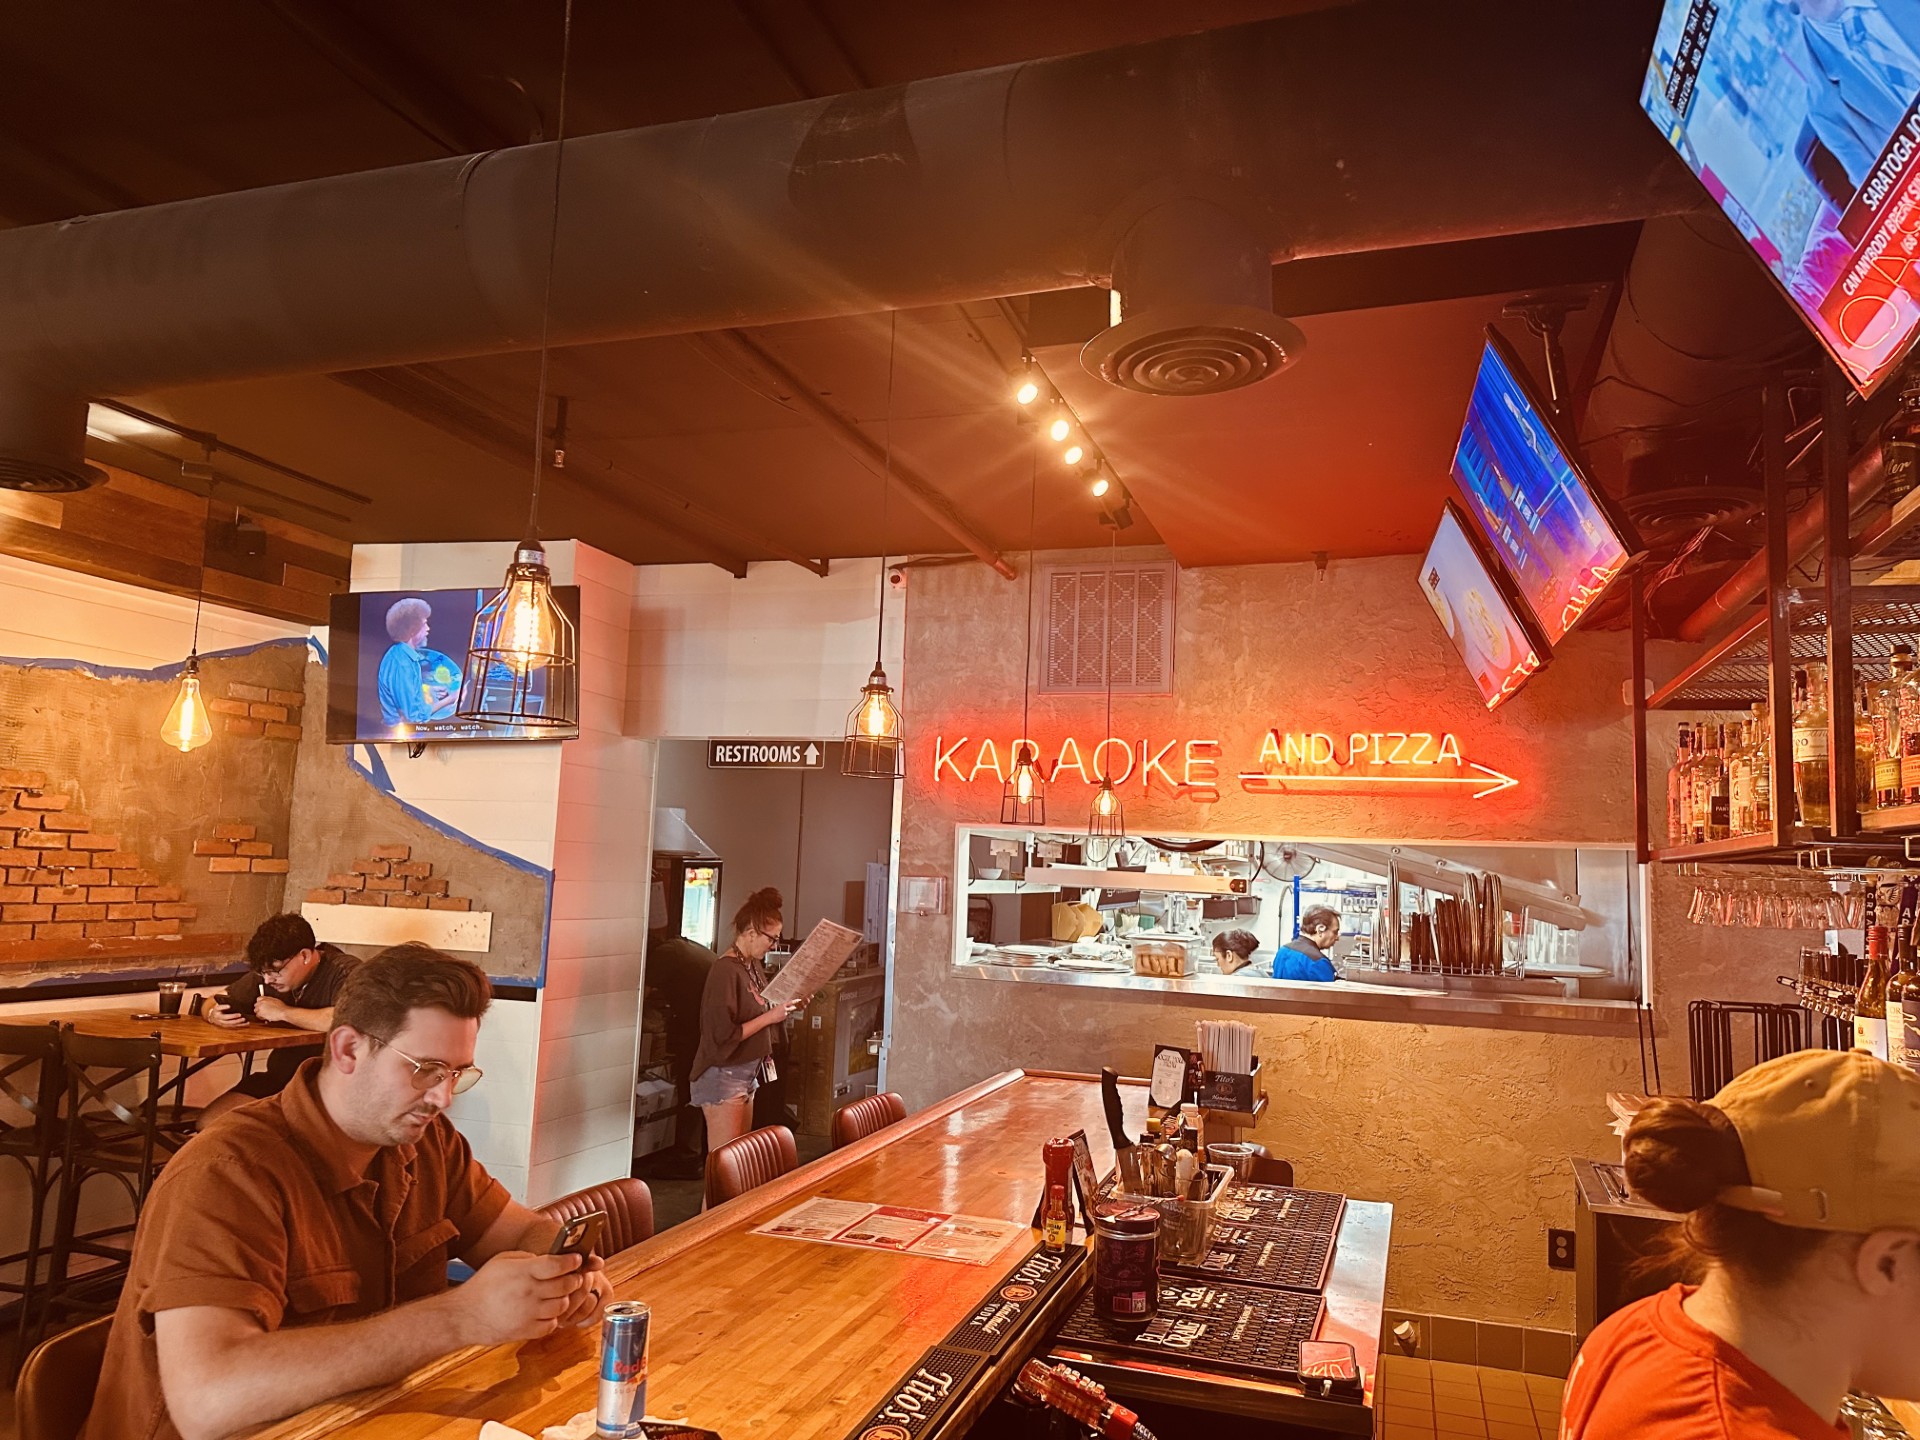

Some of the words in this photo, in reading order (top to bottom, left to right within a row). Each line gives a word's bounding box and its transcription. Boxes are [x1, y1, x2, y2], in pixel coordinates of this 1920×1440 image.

[1681, 35, 1692, 57] HAS
[1690, 48, 1702, 70] AND
[1862, 134, 1911, 212] SARATOGA
[1842, 269, 1861, 296] CAN
[1856, 229, 1892, 284] ANYBODY
[1886, 192, 1913, 231] BREAK
[715, 745, 801, 763] RESTROOMS
[934, 735, 1219, 787] KARAOKE
[1259, 732, 1334, 765] AND
[1349, 732, 1462, 766] PIZZA
[1176, 1286, 1208, 1309] PGA
[613, 1359, 640, 1374] Red
[883, 1367, 954, 1424] Tito's
